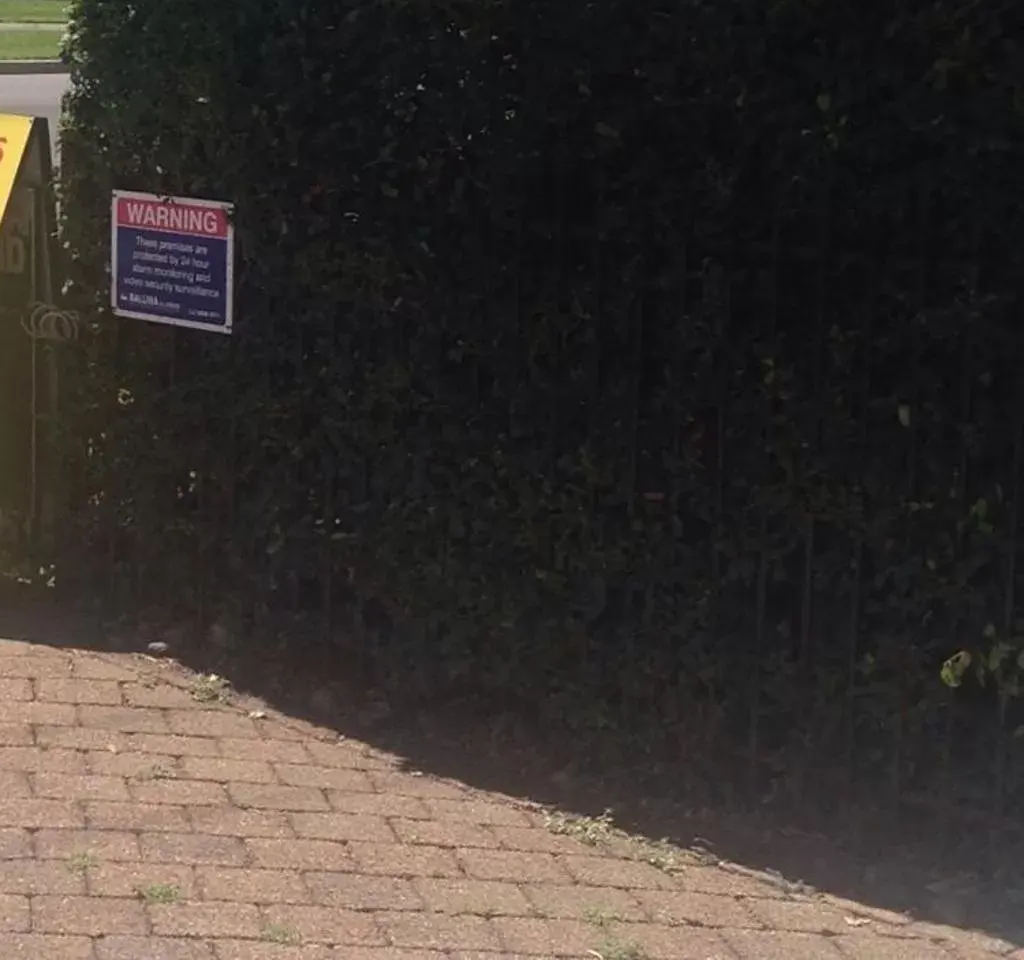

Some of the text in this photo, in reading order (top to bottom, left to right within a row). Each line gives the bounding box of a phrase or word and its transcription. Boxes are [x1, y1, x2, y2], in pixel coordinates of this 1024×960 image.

[127, 203, 218, 233] WARNING
[136, 236, 208, 255] These premises are
[132, 250, 168, 264] protected
[169, 255, 178, 265] by
[192, 257, 210, 269] hour
[154, 268, 194, 283] monitoring
[195, 273, 211, 283] and
[144, 280, 174, 293] security
